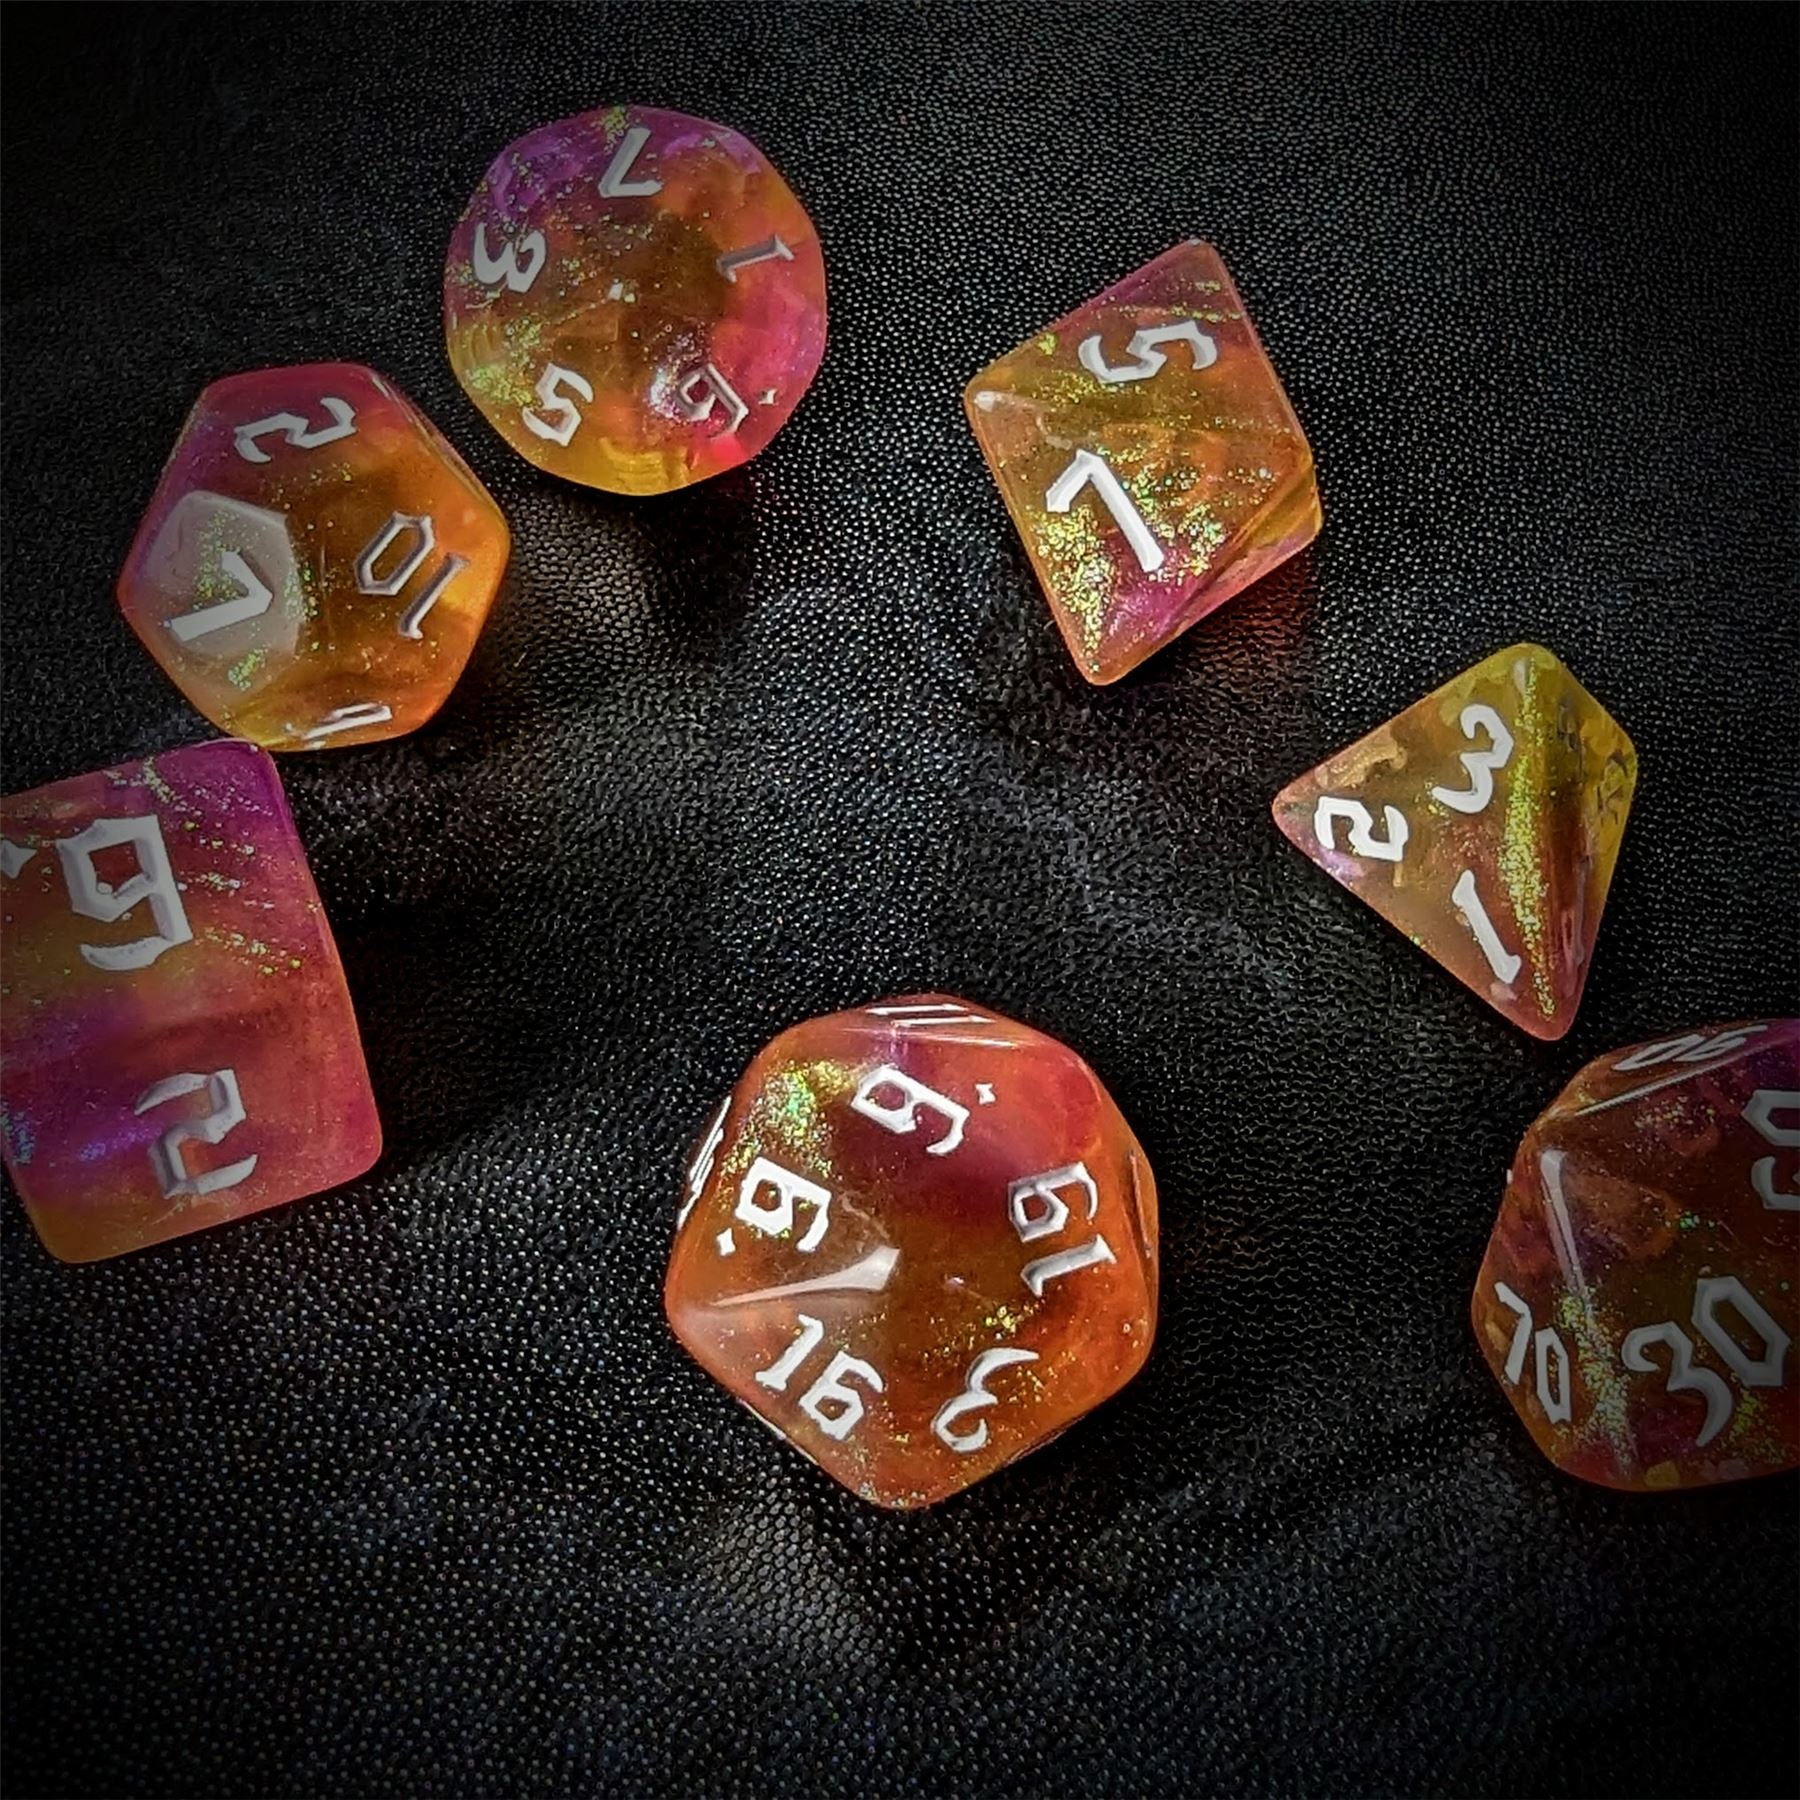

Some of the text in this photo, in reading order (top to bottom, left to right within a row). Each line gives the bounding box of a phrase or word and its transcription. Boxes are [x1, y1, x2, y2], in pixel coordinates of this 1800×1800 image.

[599, 127, 663, 198] 7
[473, 222, 547, 294] 3
[715, 234, 795, 283] 1
[522, 363, 594, 447] 5
[1078, 319, 1218, 384] 5
[233, 396, 357, 464] 2
[1045, 449, 1164, 573] 7
[160, 549, 273, 643] 7
[353, 510, 470, 640] 10
[1431, 703, 1515, 815] 3
[1313, 795, 1410, 863] 2
[1451, 869, 1523, 985] 1
[134, 1068, 258, 1199] 2
[1008, 1160, 1118, 1297] 19
[755, 1313, 885, 1442] 16
[930, 1347, 1041, 1453] 3
[1494, 1281, 1572, 1424] 70
[1621, 1276, 1791, 1447] 30
